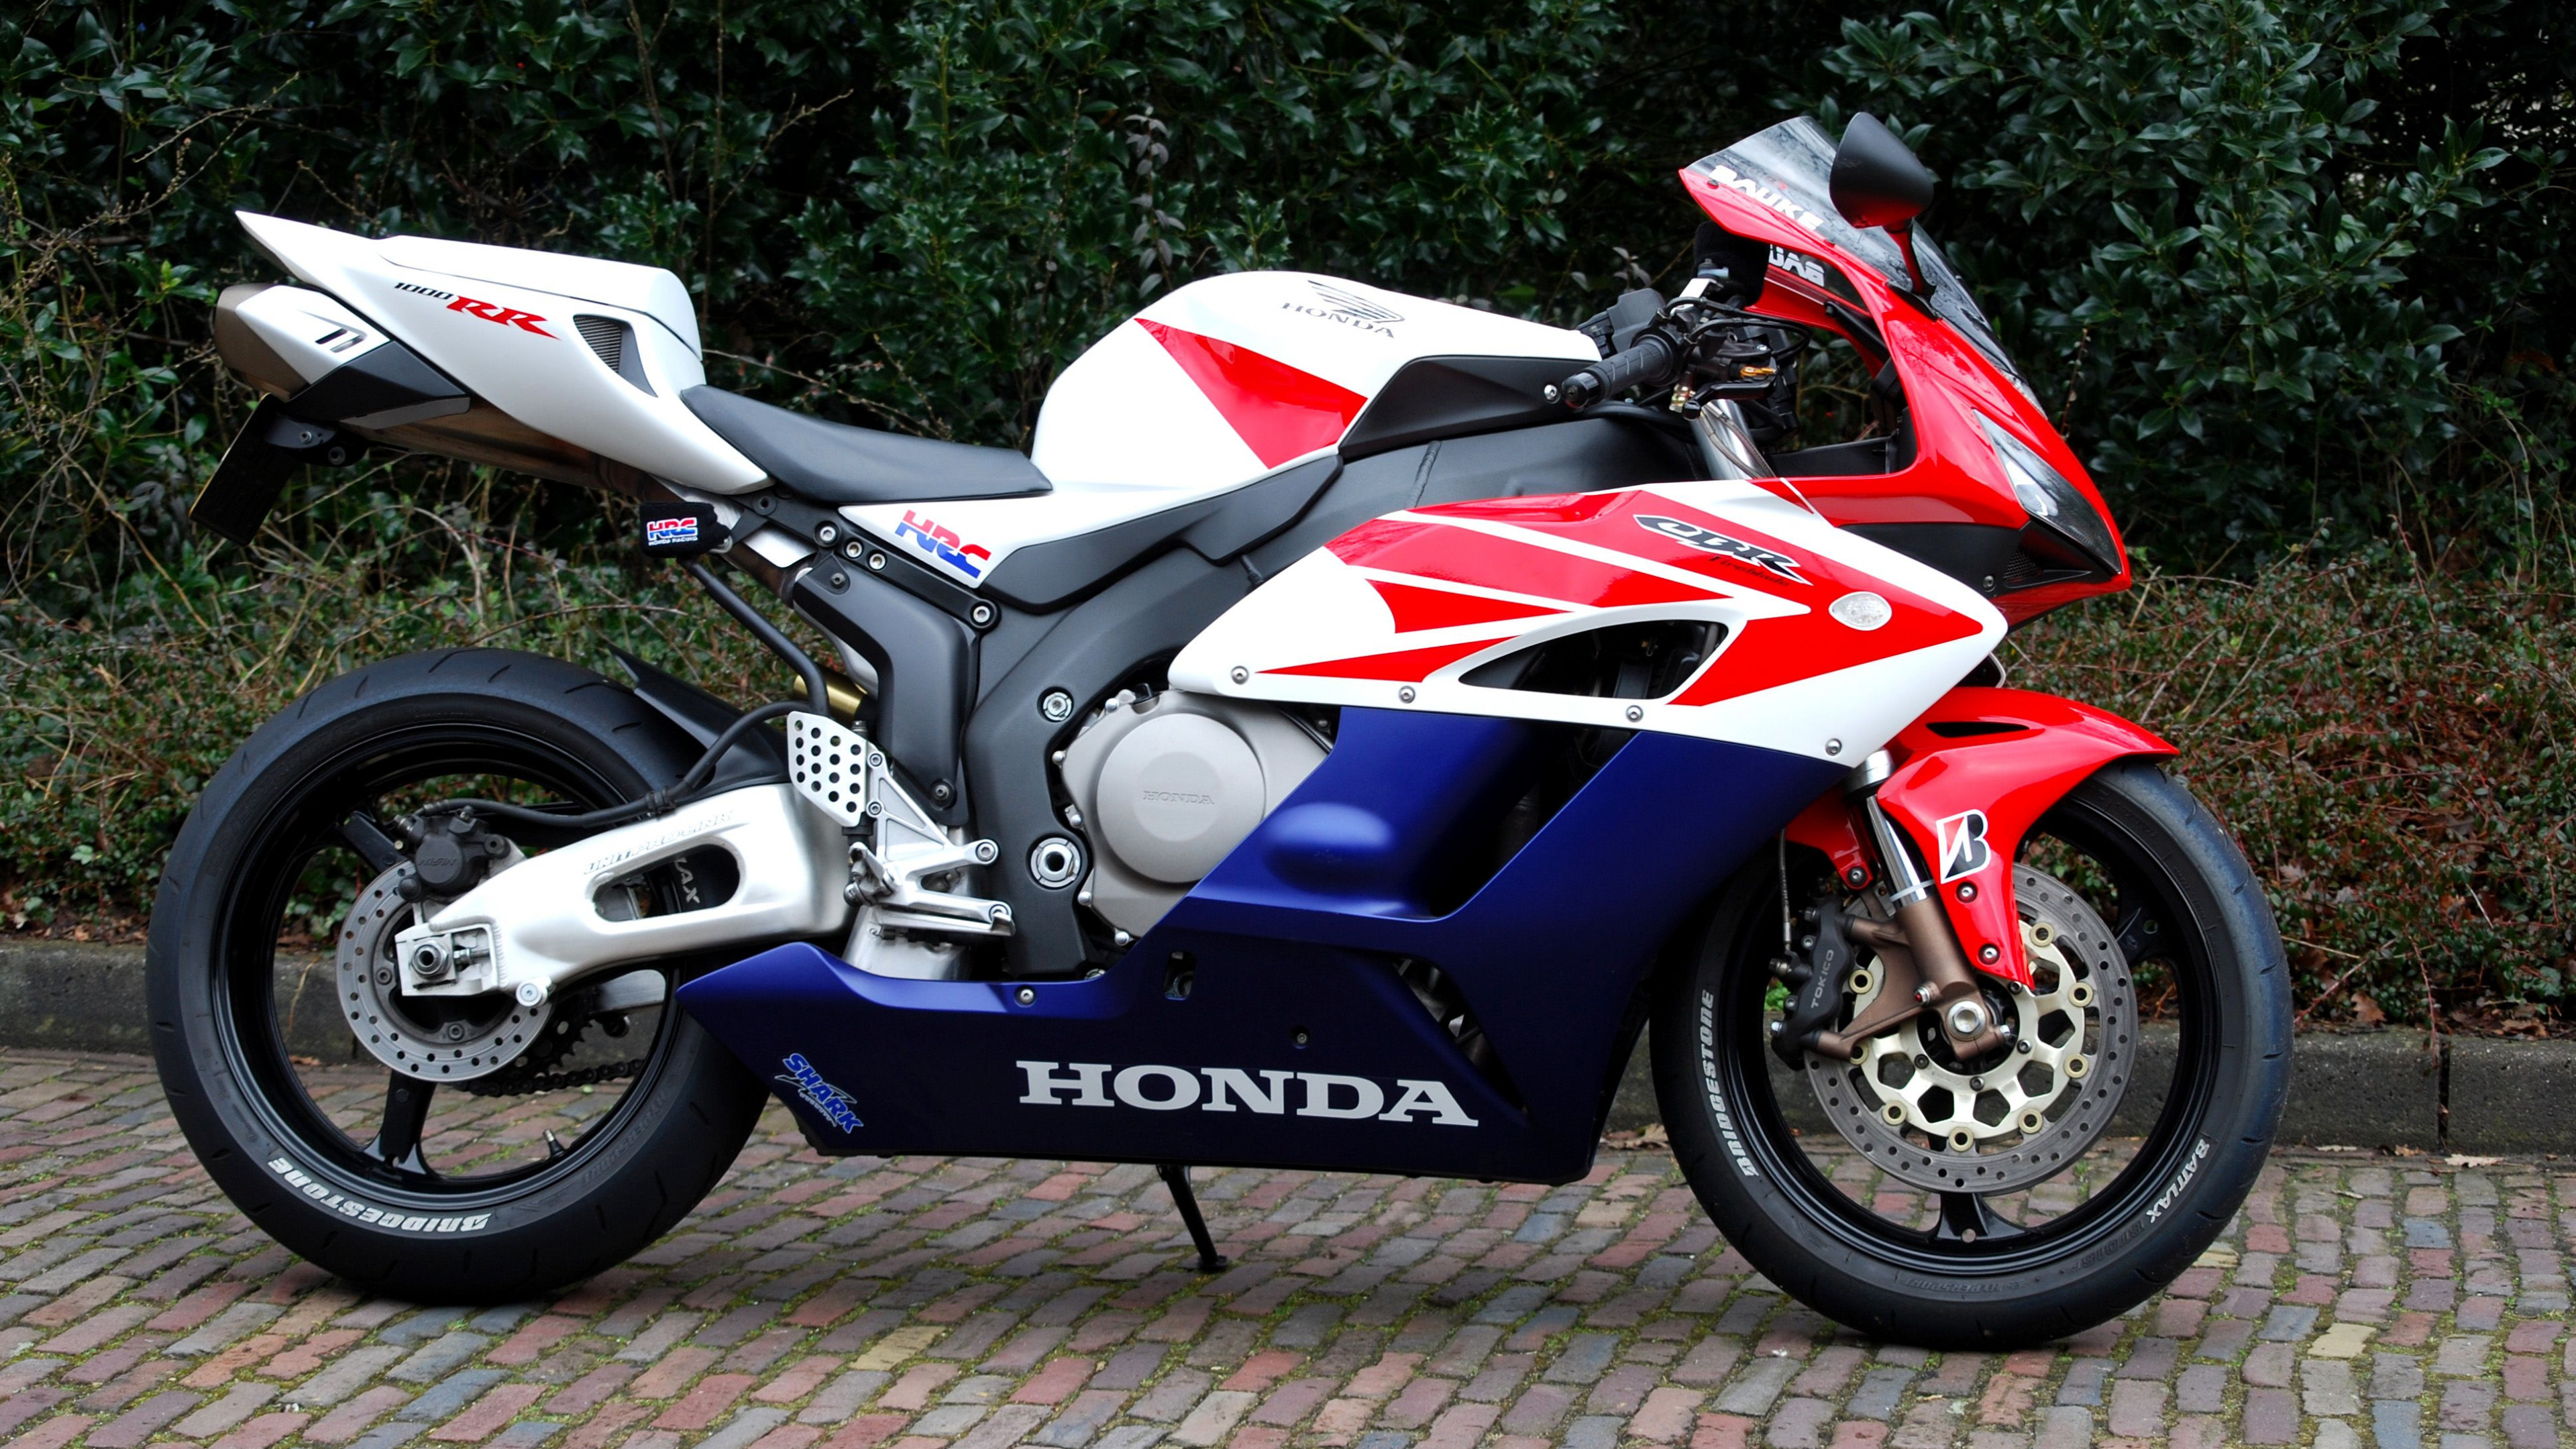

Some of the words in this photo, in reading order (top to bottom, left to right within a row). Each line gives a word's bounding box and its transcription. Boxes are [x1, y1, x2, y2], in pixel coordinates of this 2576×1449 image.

[394, 282, 453, 300] 1000
[446, 295, 561, 340] RR
[1281, 303, 1395, 338] HONDA
[646, 517, 698, 541] HRC
[895, 509, 991, 579] HRC
[1633, 514, 1813, 586] CBR
[1142, 791, 1215, 805] HONDA
[1811, 949, 1834, 1009] TOKICO
[782, 1053, 864, 1134] SHARK
[1016, 1060, 1479, 1127] HONDA
[1700, 989, 1758, 1177] BRIDGESTONE
[268, 1156, 490, 1234] BRIDGESTONE
[2145, 1138, 2211, 1224] BATTLAX
